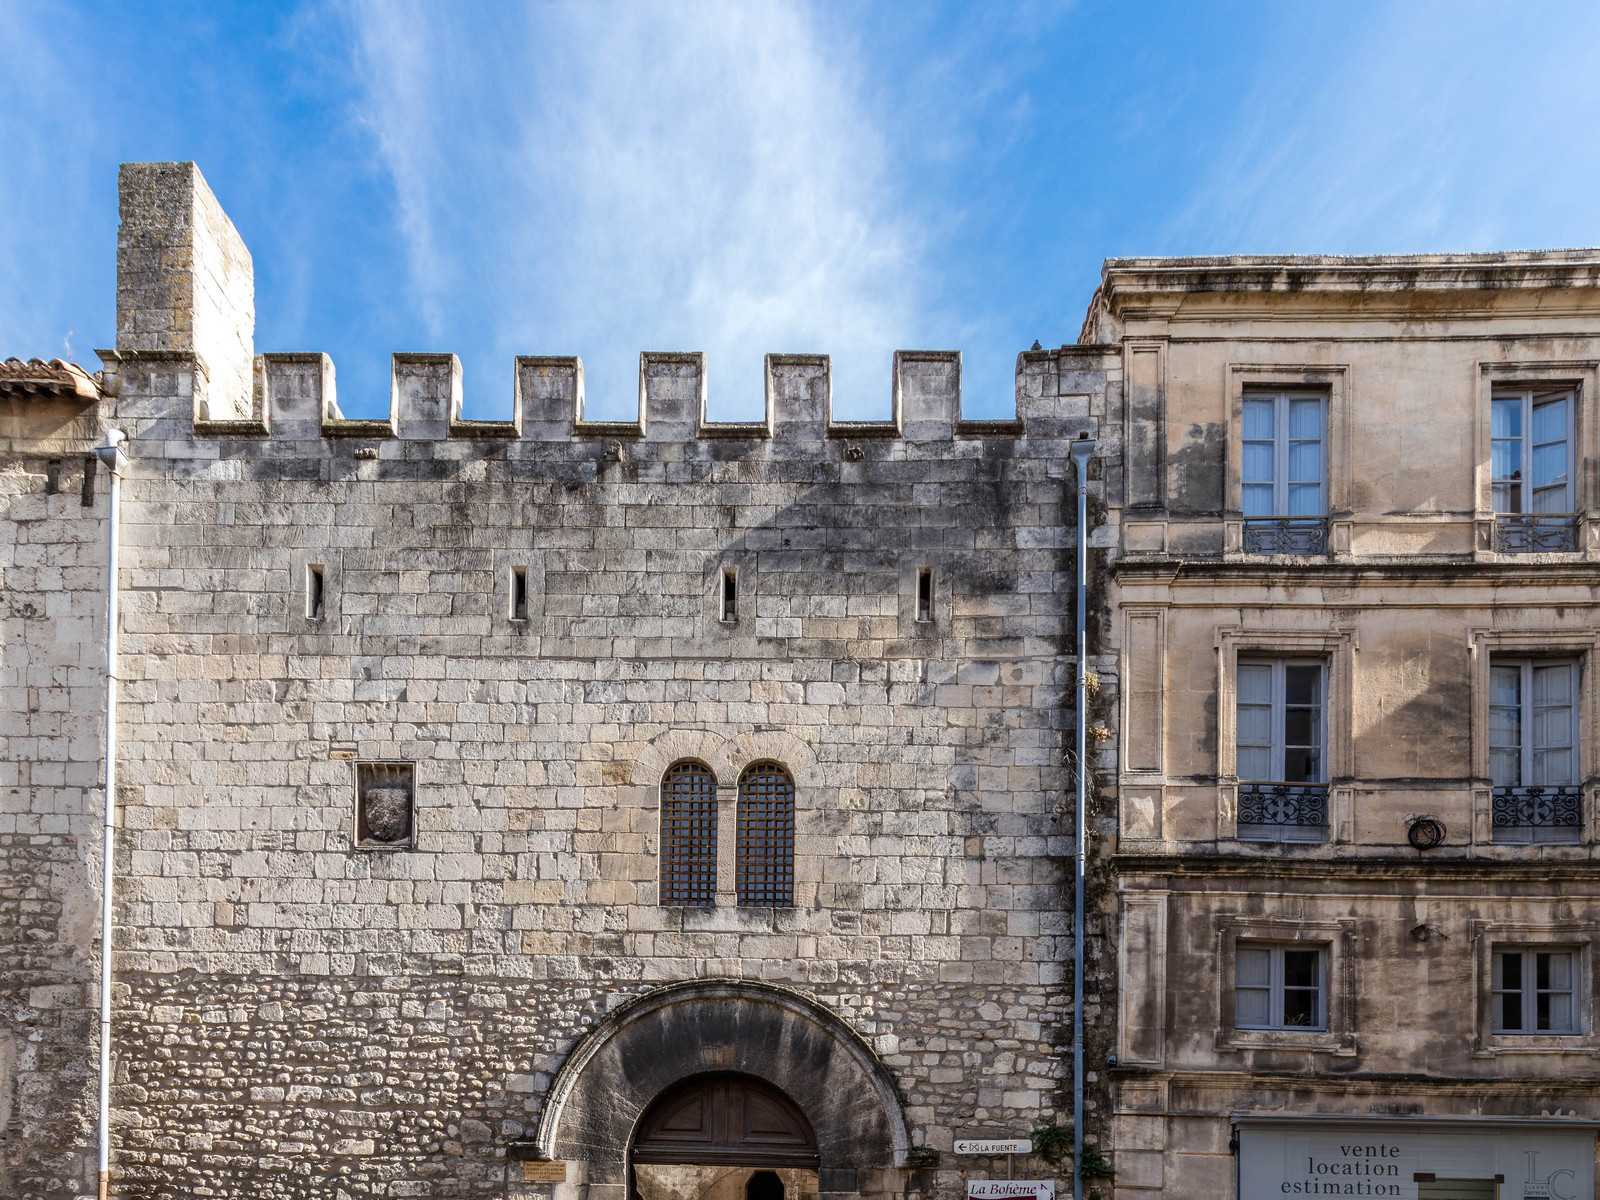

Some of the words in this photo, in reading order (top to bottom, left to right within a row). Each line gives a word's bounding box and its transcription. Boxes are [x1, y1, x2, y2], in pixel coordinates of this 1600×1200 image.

[991, 1144, 1018, 1152] FUENTE
[1340, 1144, 1400, 1158] vente
[1308, 1157, 1399, 1176] location
[970, 1184, 986, 1195] La
[990, 1183, 1037, 1195] Bohème
[1281, 1178, 1401, 1196] estimation
